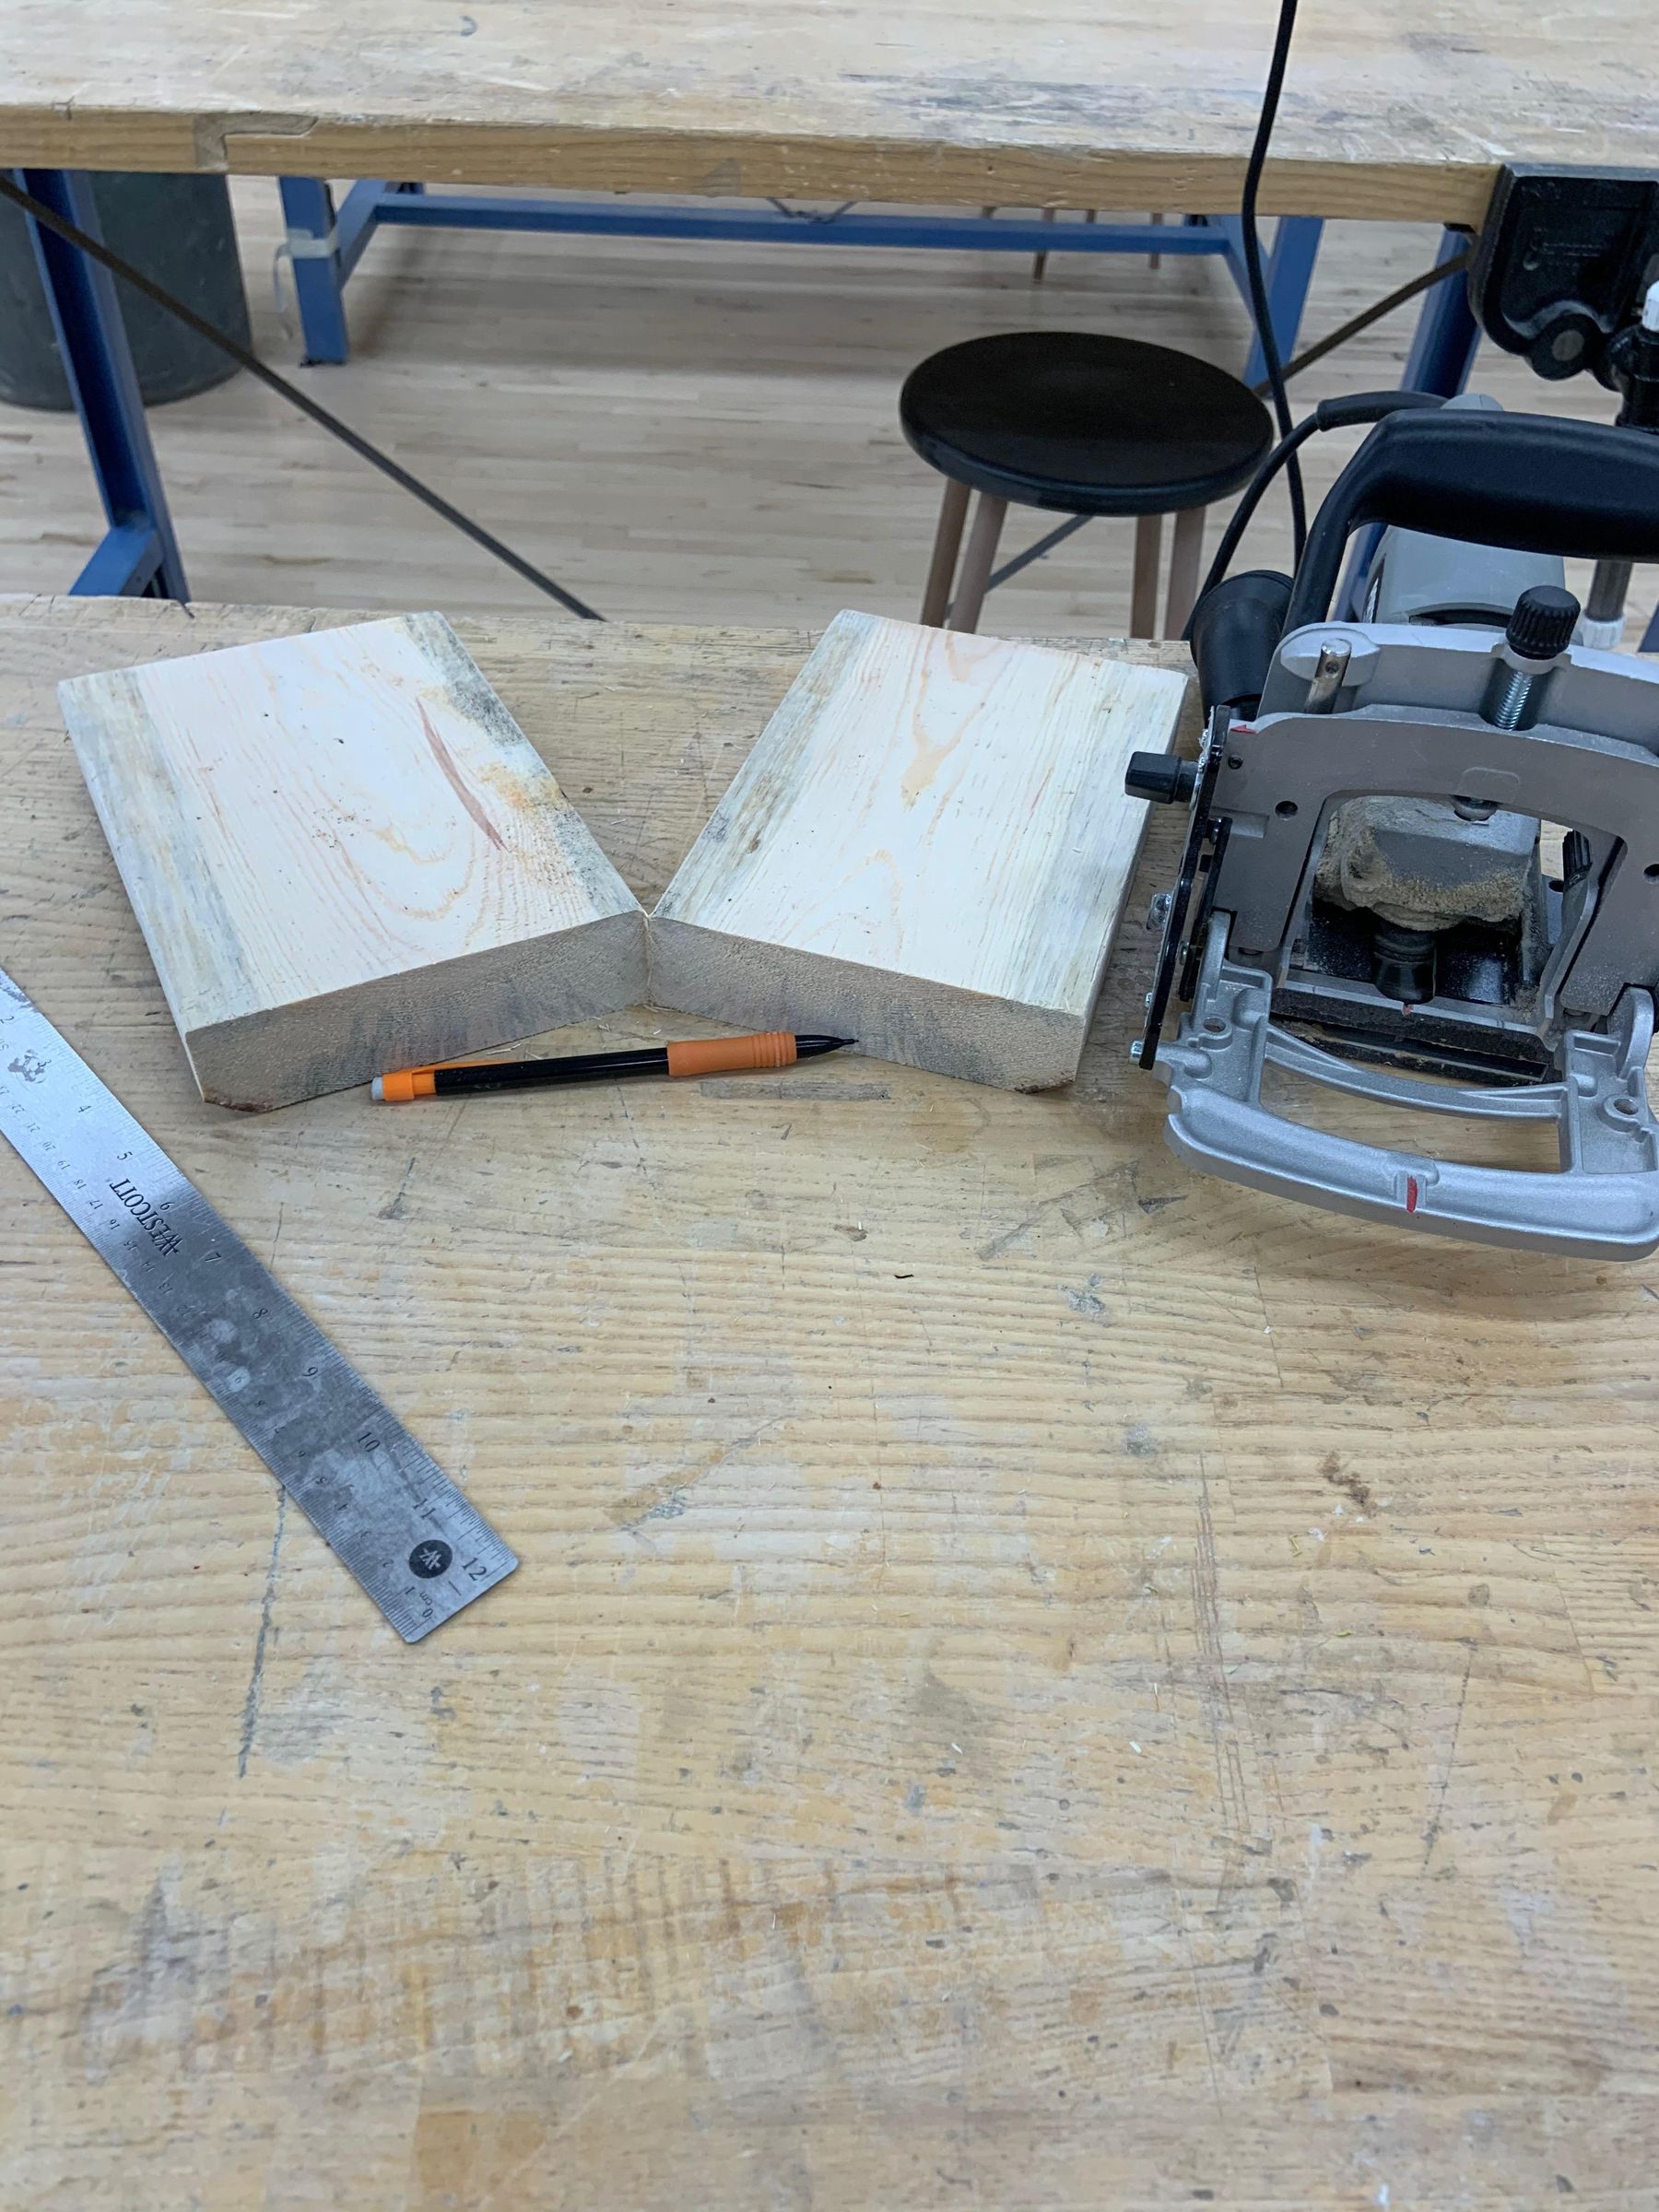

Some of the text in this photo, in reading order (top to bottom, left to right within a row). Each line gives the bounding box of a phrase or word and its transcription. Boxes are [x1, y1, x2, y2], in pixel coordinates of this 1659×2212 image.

[11, 1104, 25, 1113] 22
[28, 1122, 41, 1133] 21
[42, 1141, 56, 1151] 20
[73, 1179, 87, 1191] 18
[109, 1178, 182, 1257] WESTCOTT
[110, 1218, 120, 1230] 16
[78, 1105, 91, 1113] 4
[116, 1150, 133, 1160] 5
[159, 1201, 175, 1211] 6
[205, 1252, 222, 1263] 7
[253, 1308, 268, 1320] 8
[301, 1366, 318, 1377] 9
[358, 1432, 381, 1453] 10
[413, 1498, 436, 1520] 11
[462, 1557, 487, 1582] 12
[419, 1592, 433, 1606] cm
[421, 1607, 434, 1618] 0
